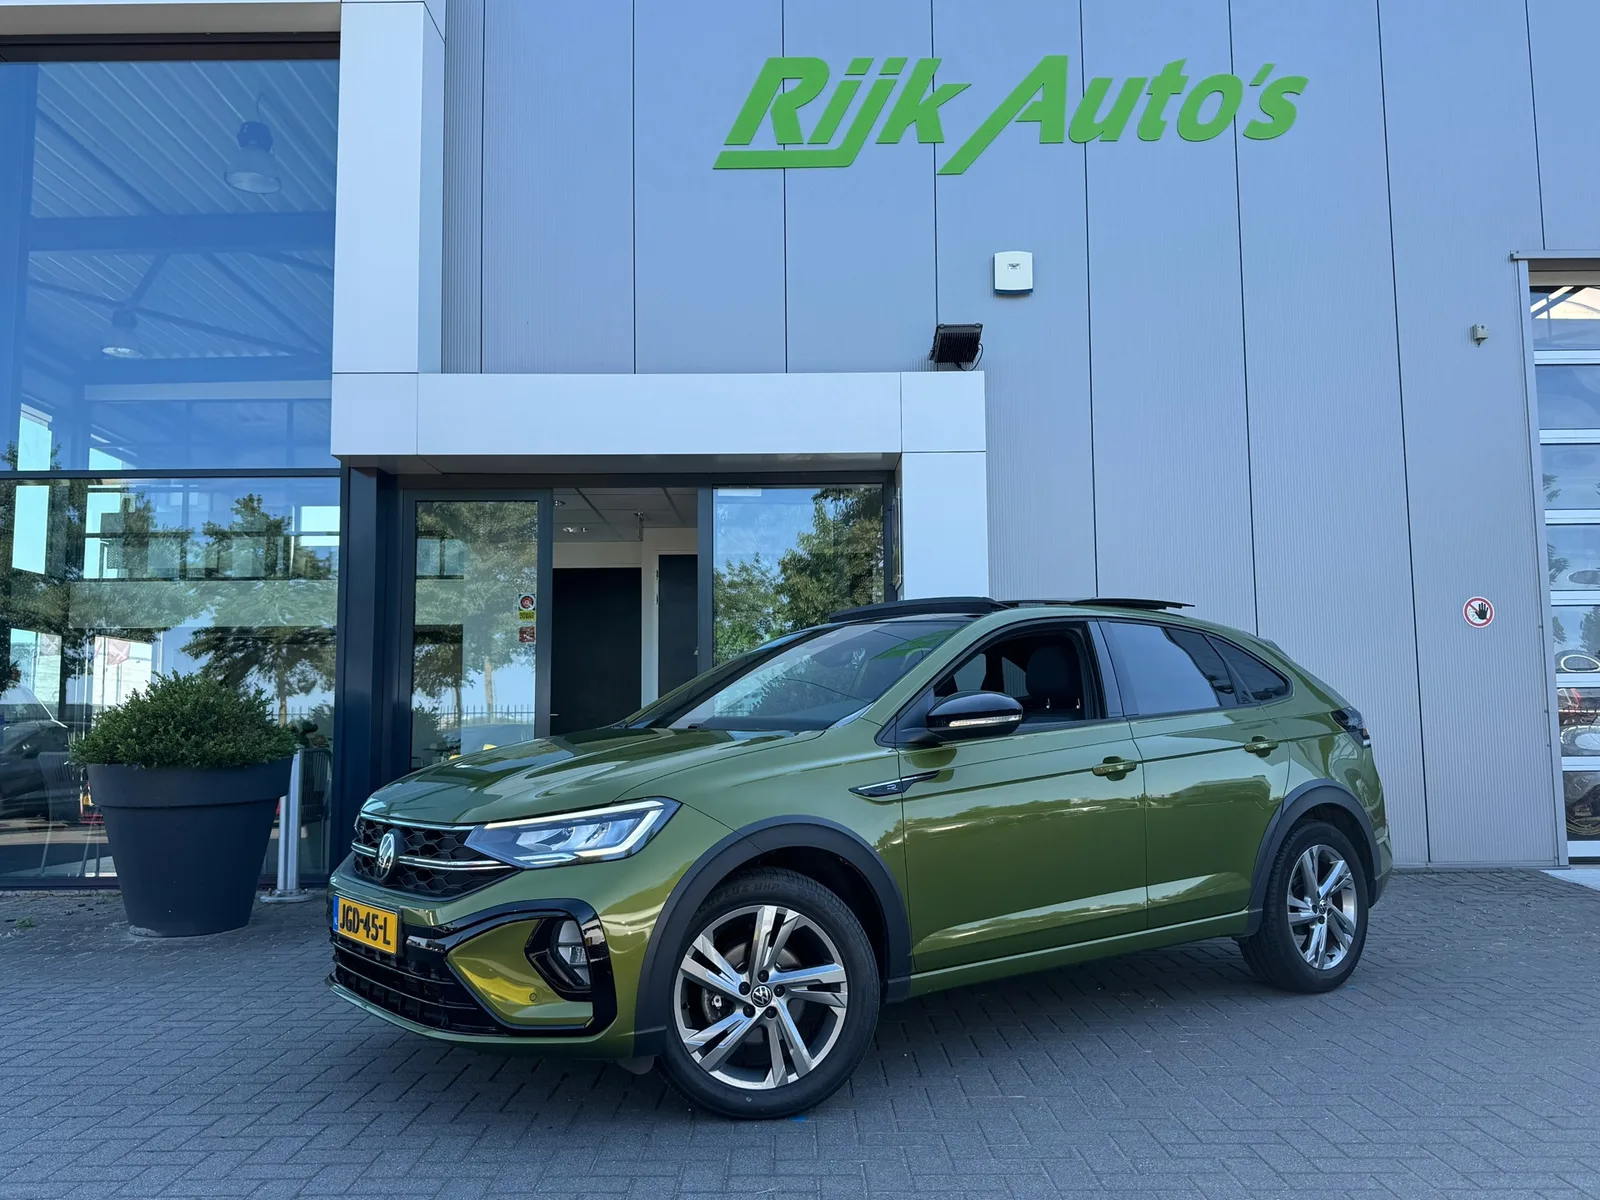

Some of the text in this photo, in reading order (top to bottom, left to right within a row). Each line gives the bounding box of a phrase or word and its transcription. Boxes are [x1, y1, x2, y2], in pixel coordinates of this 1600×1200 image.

[713, 54, 1310, 175] Rijk Auto's
[340, 903, 391, 946] JGD-45-L
